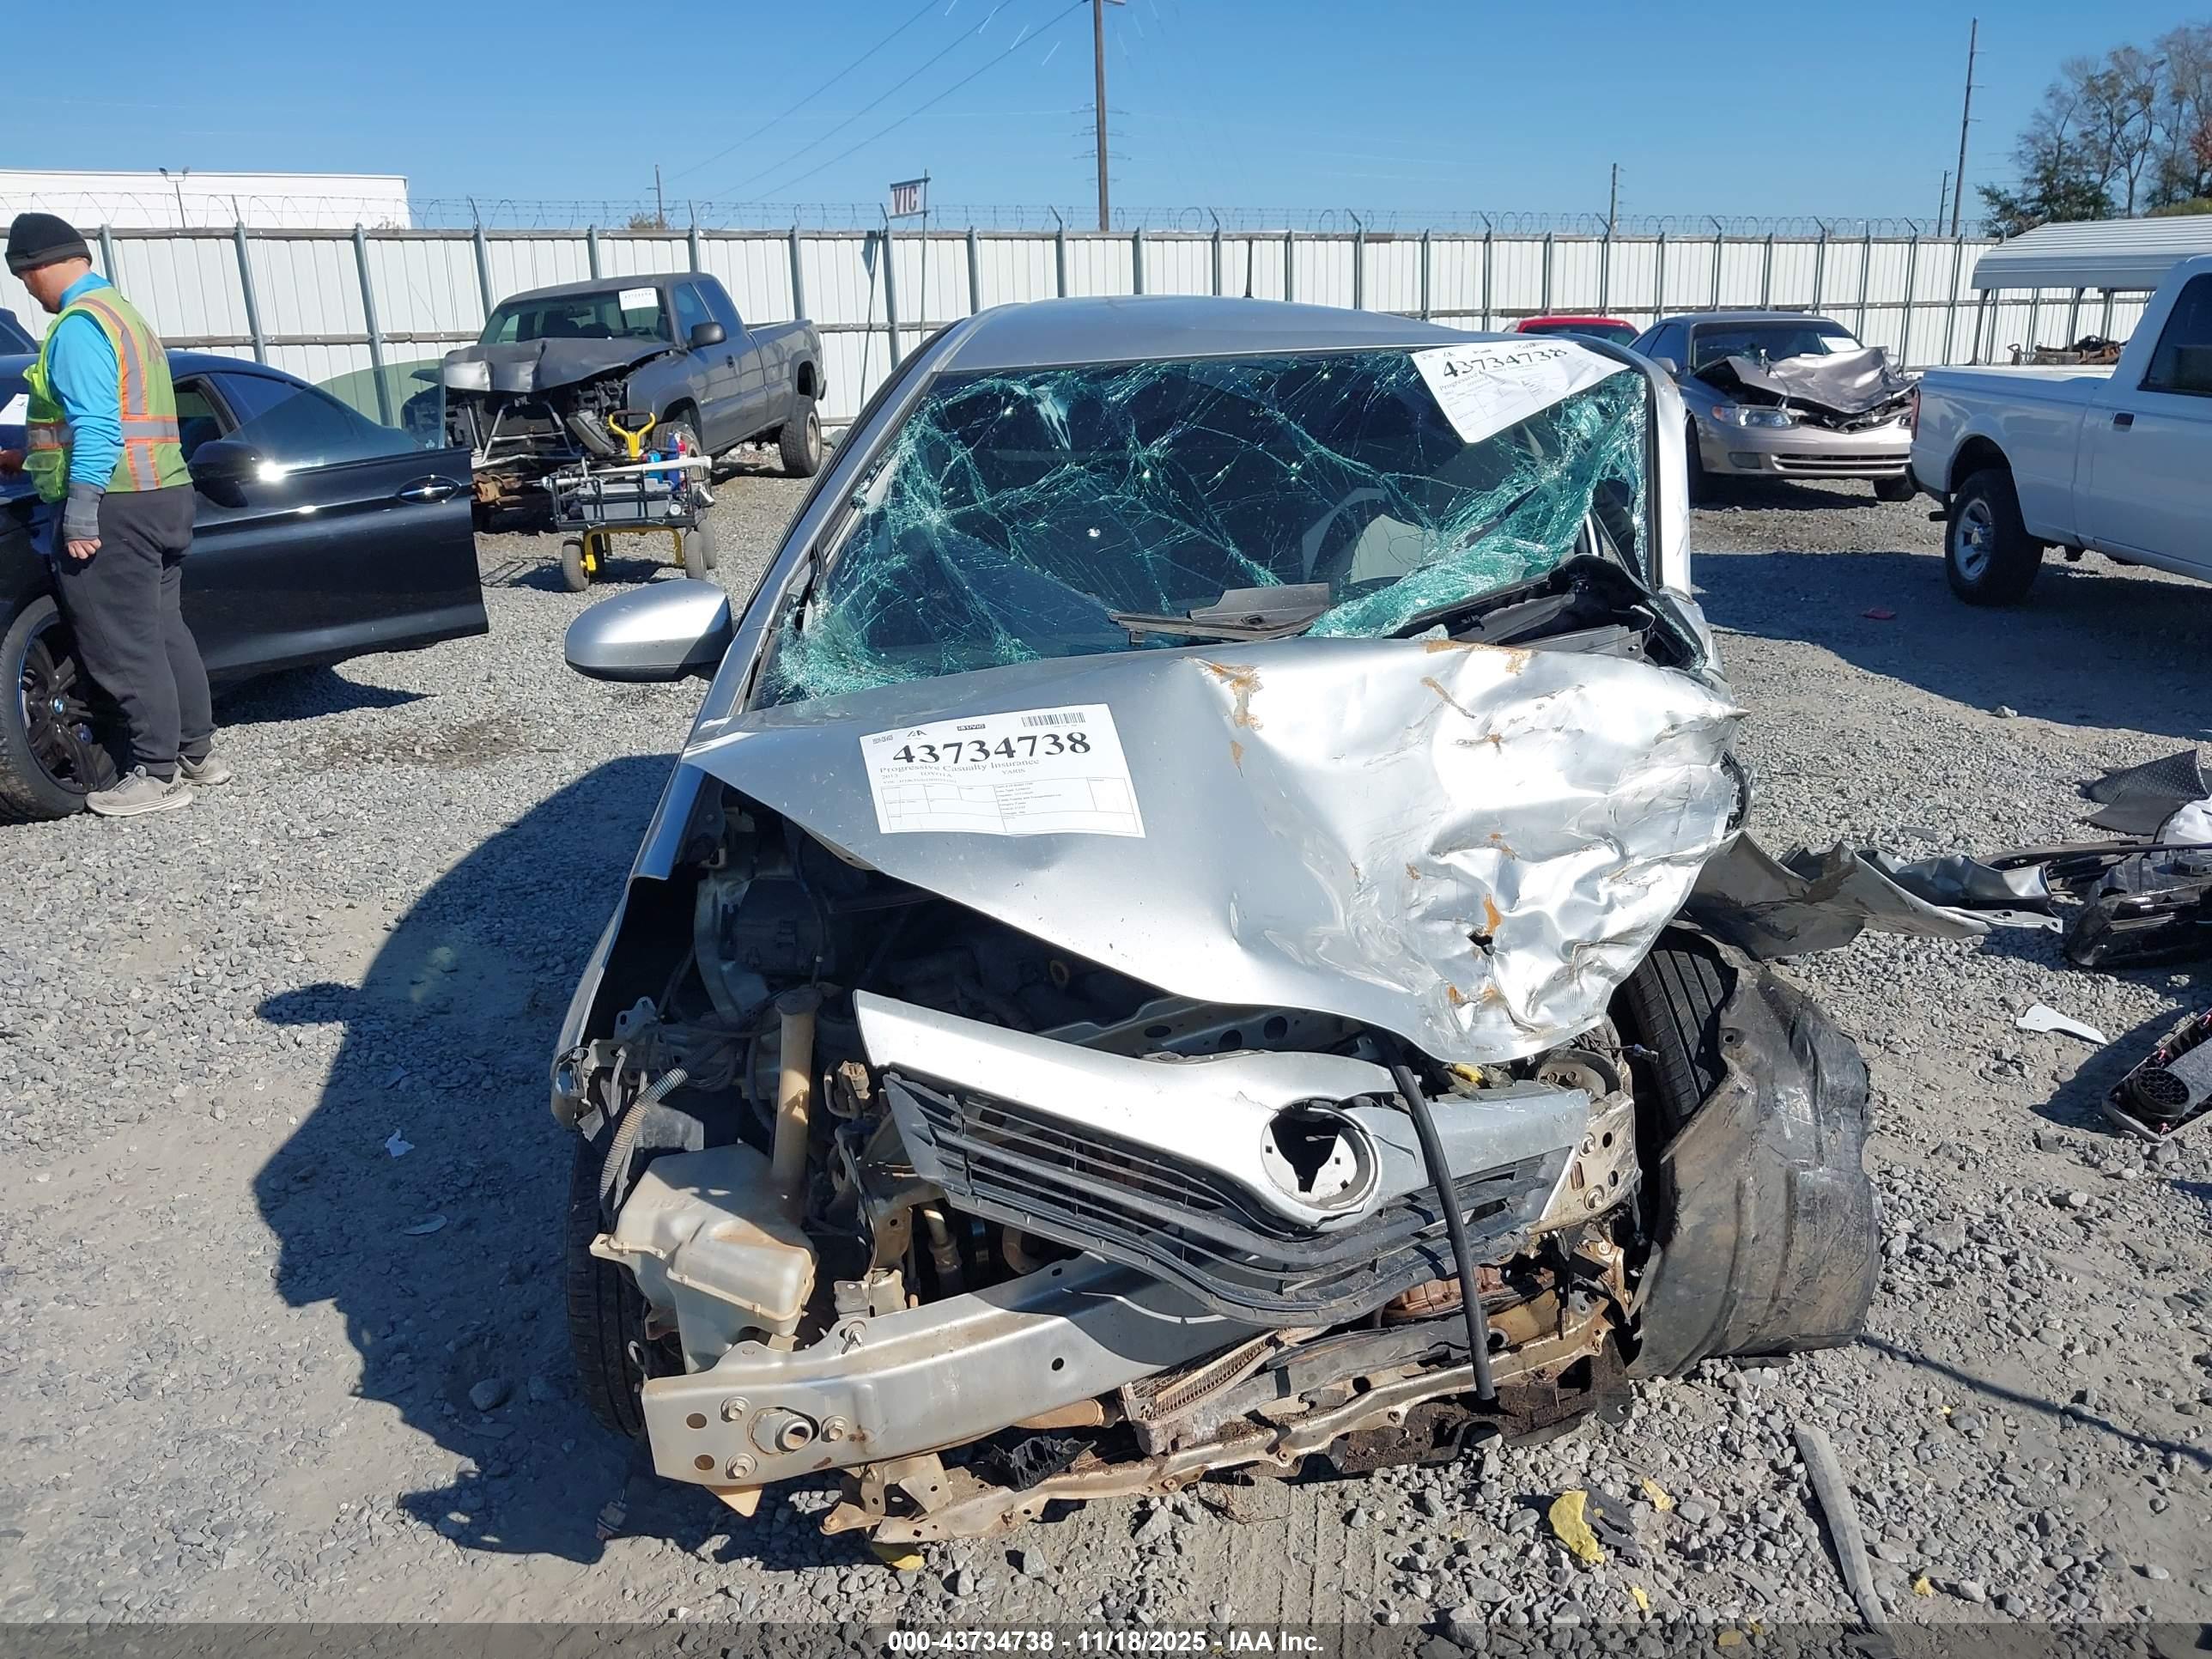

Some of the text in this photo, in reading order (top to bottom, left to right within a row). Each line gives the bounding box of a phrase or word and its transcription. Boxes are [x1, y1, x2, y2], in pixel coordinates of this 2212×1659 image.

[894, 185, 917, 214] VIC
[1443, 349, 1567, 377] 43734738
[893, 732, 1091, 764] 43734738
[943, 763, 987, 772] Casualty
[991, 759, 1039, 769] Insurance
[161, 781, 184, 799] HOKA
